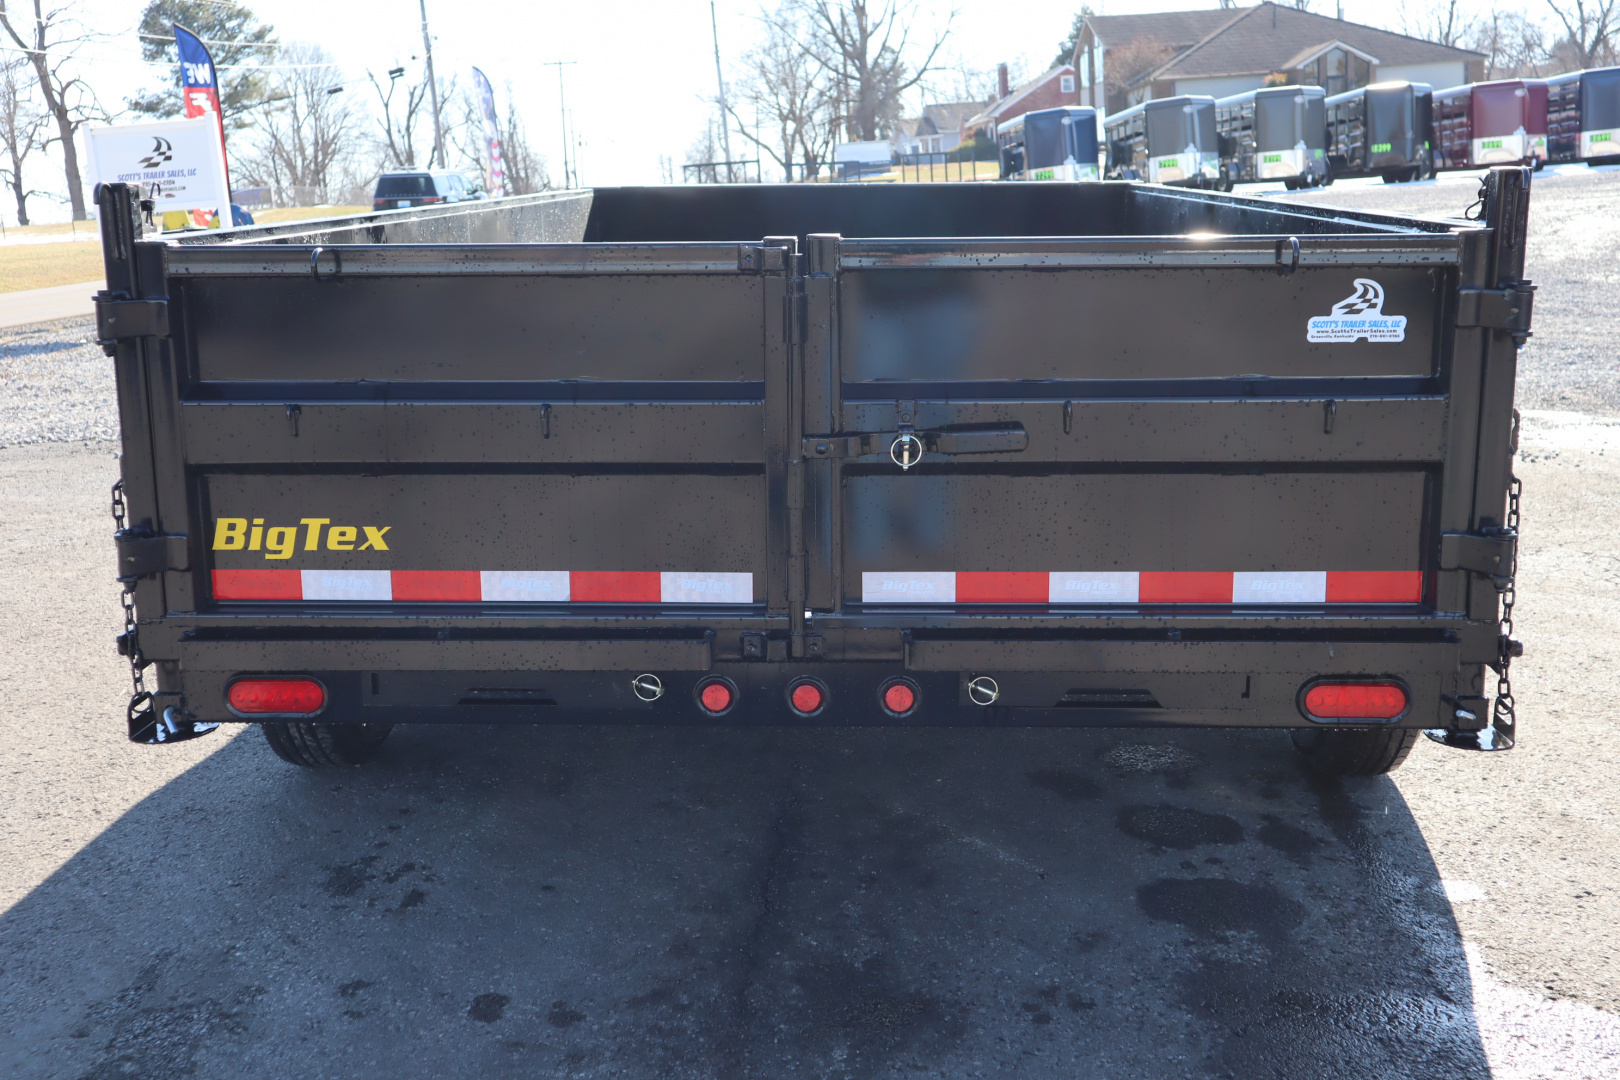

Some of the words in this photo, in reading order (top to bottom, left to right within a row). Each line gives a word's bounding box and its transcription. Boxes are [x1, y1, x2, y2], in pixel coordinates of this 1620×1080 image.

[117, 172, 142, 181] SCOTT'S
[143, 171, 165, 180] TRAILER
[167, 169, 186, 178] SALES,
[187, 168, 197, 176] LLC
[1311, 320, 1339, 329] SCOTT'S
[1340, 320, 1366, 328] TRAILER
[1367, 320, 1389, 329] SALES,
[1390, 320, 1402, 328] LLC
[211, 517, 392, 560] BigTex
